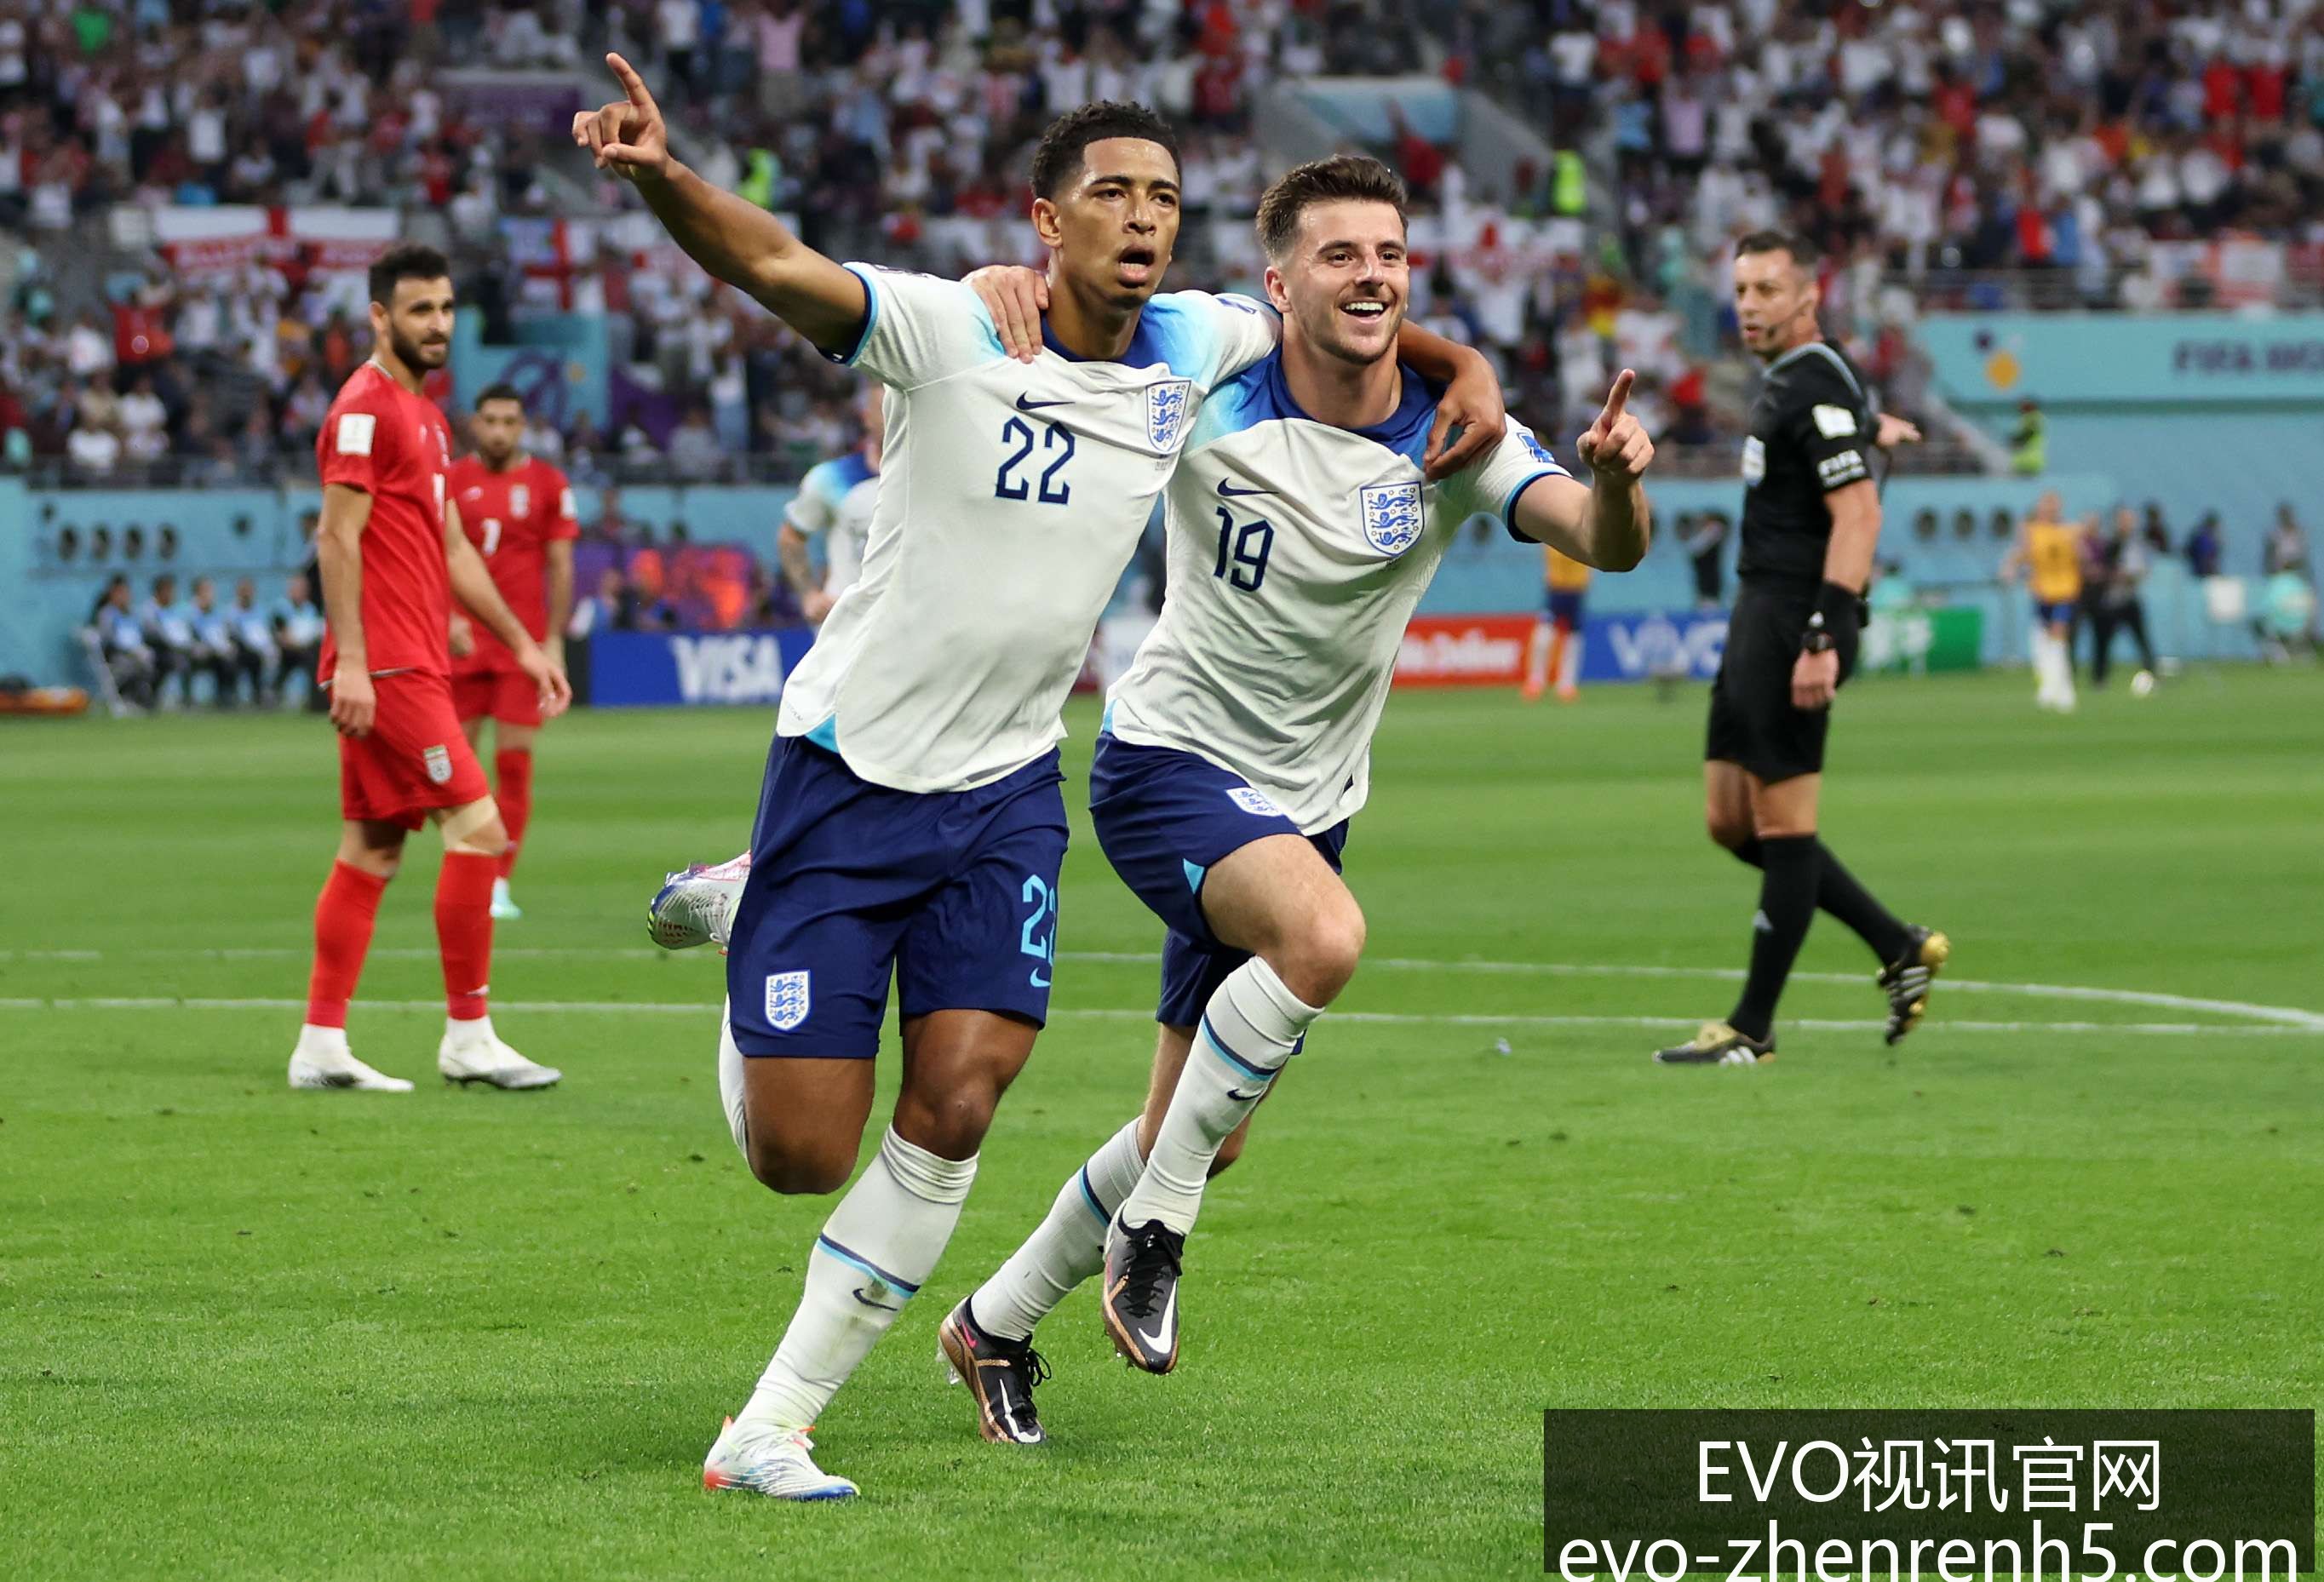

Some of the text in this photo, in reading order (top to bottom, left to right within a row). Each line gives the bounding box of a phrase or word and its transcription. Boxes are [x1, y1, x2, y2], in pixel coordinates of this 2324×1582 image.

[995, 415, 1076, 506] 22
[1213, 506, 1276, 593] 19
[668, 634, 785, 703] VISA
